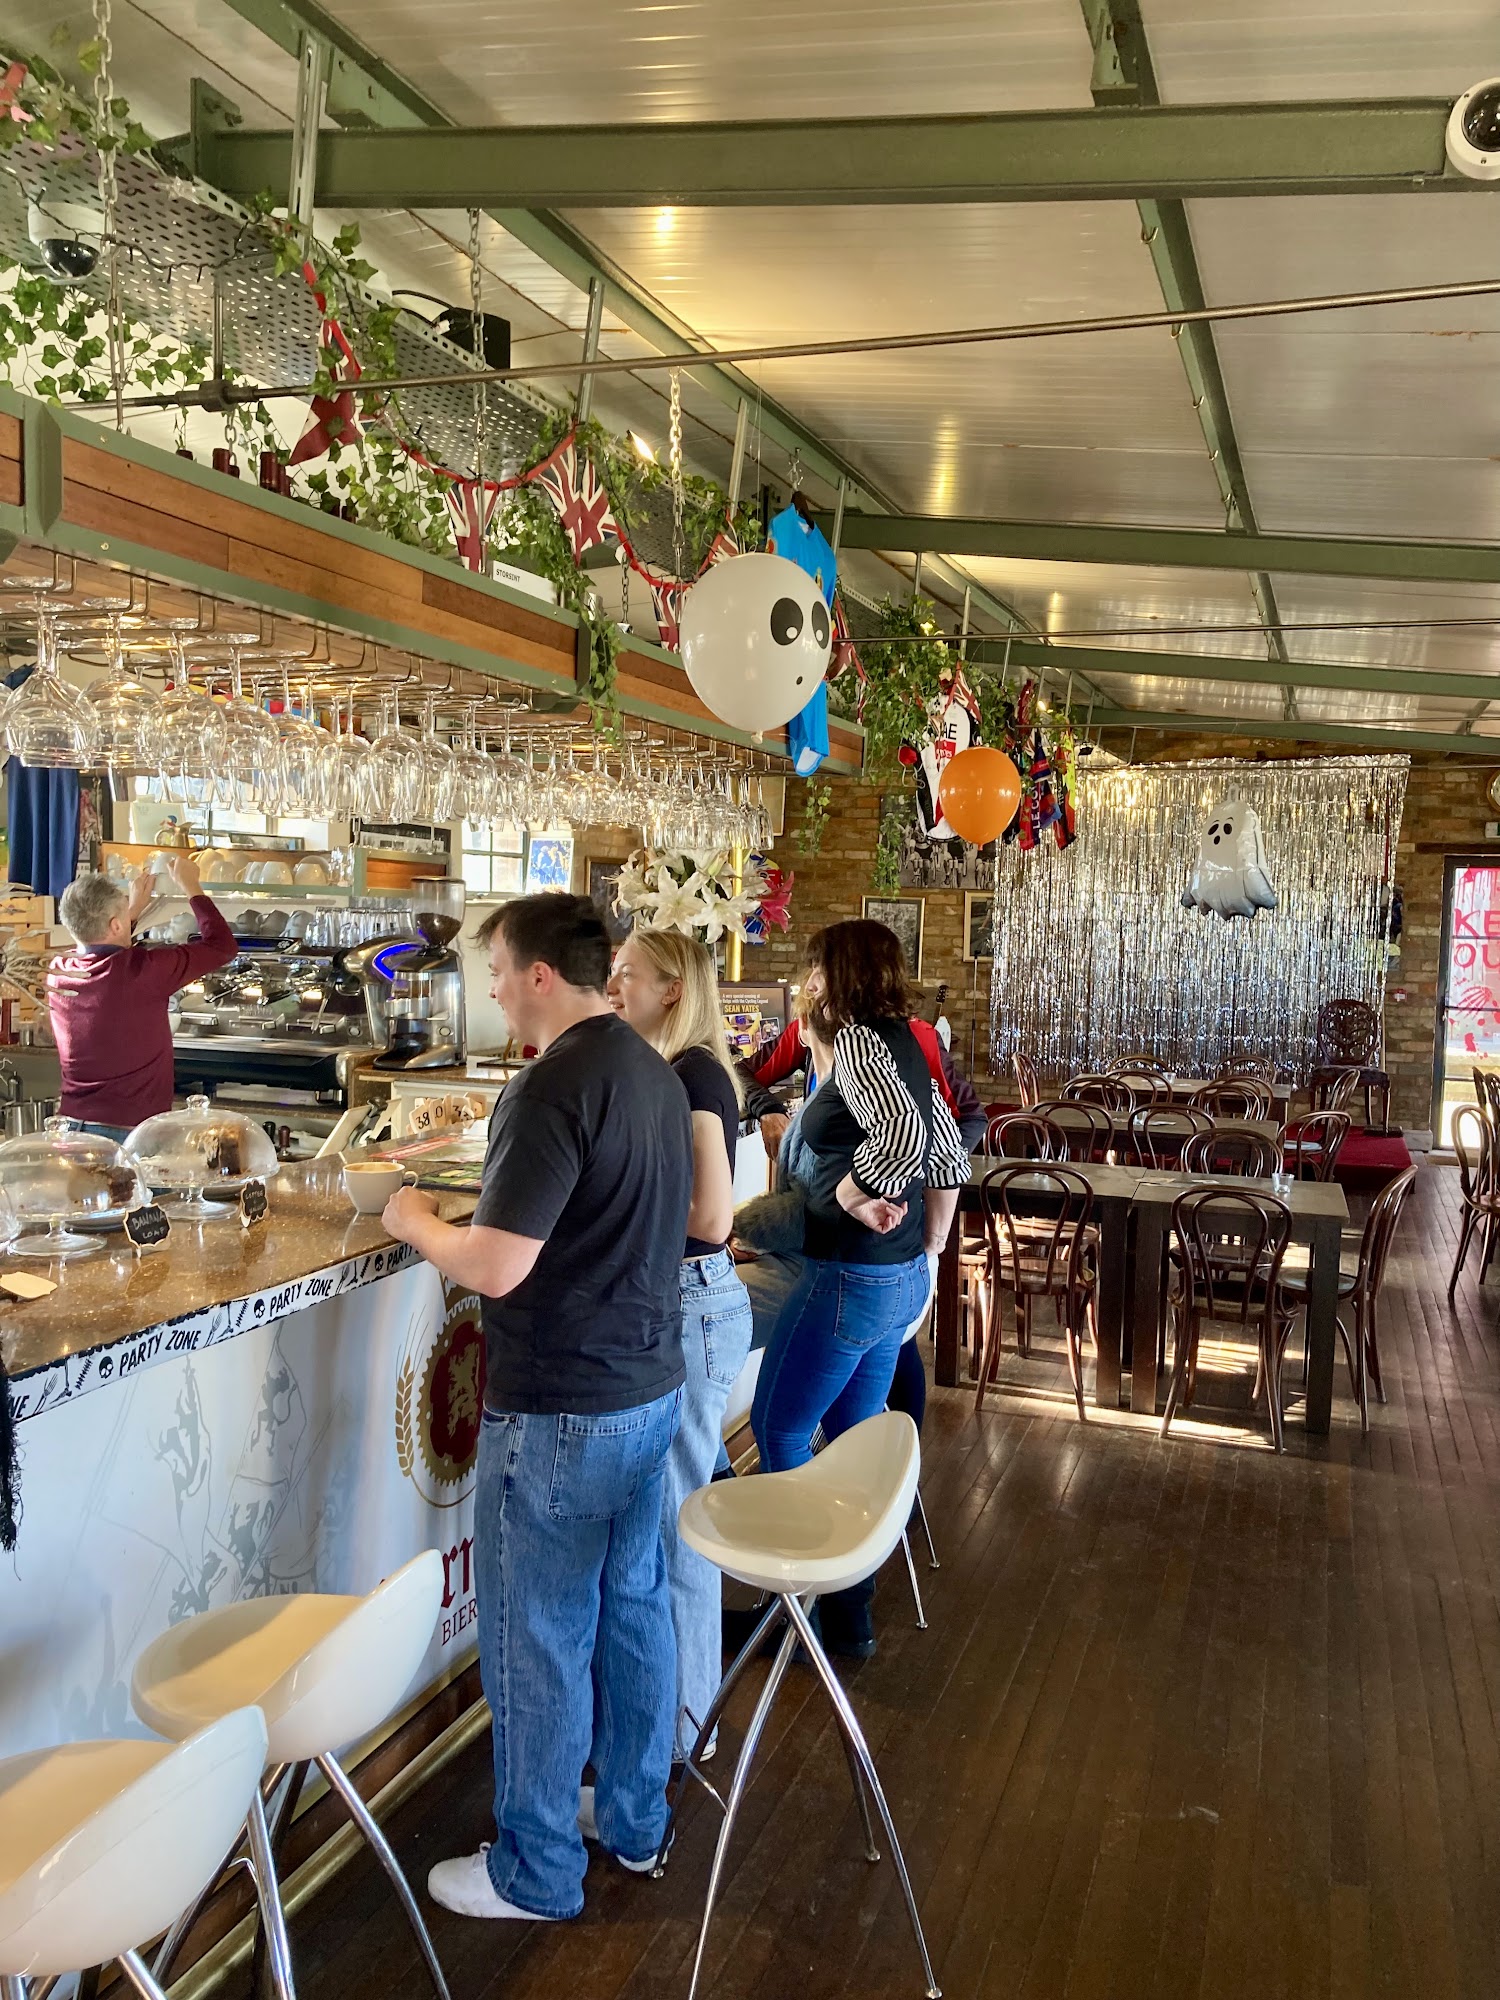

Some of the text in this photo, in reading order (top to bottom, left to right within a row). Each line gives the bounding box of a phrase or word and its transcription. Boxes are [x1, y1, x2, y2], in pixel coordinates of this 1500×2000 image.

[416, 1112, 430, 1129] 38
[119, 1331, 163, 1377] PARTY
[165, 1330, 201, 1350] ZONE
[269, 1282, 302, 1317] PARTY
[305, 1278, 333, 1297] ZONE
